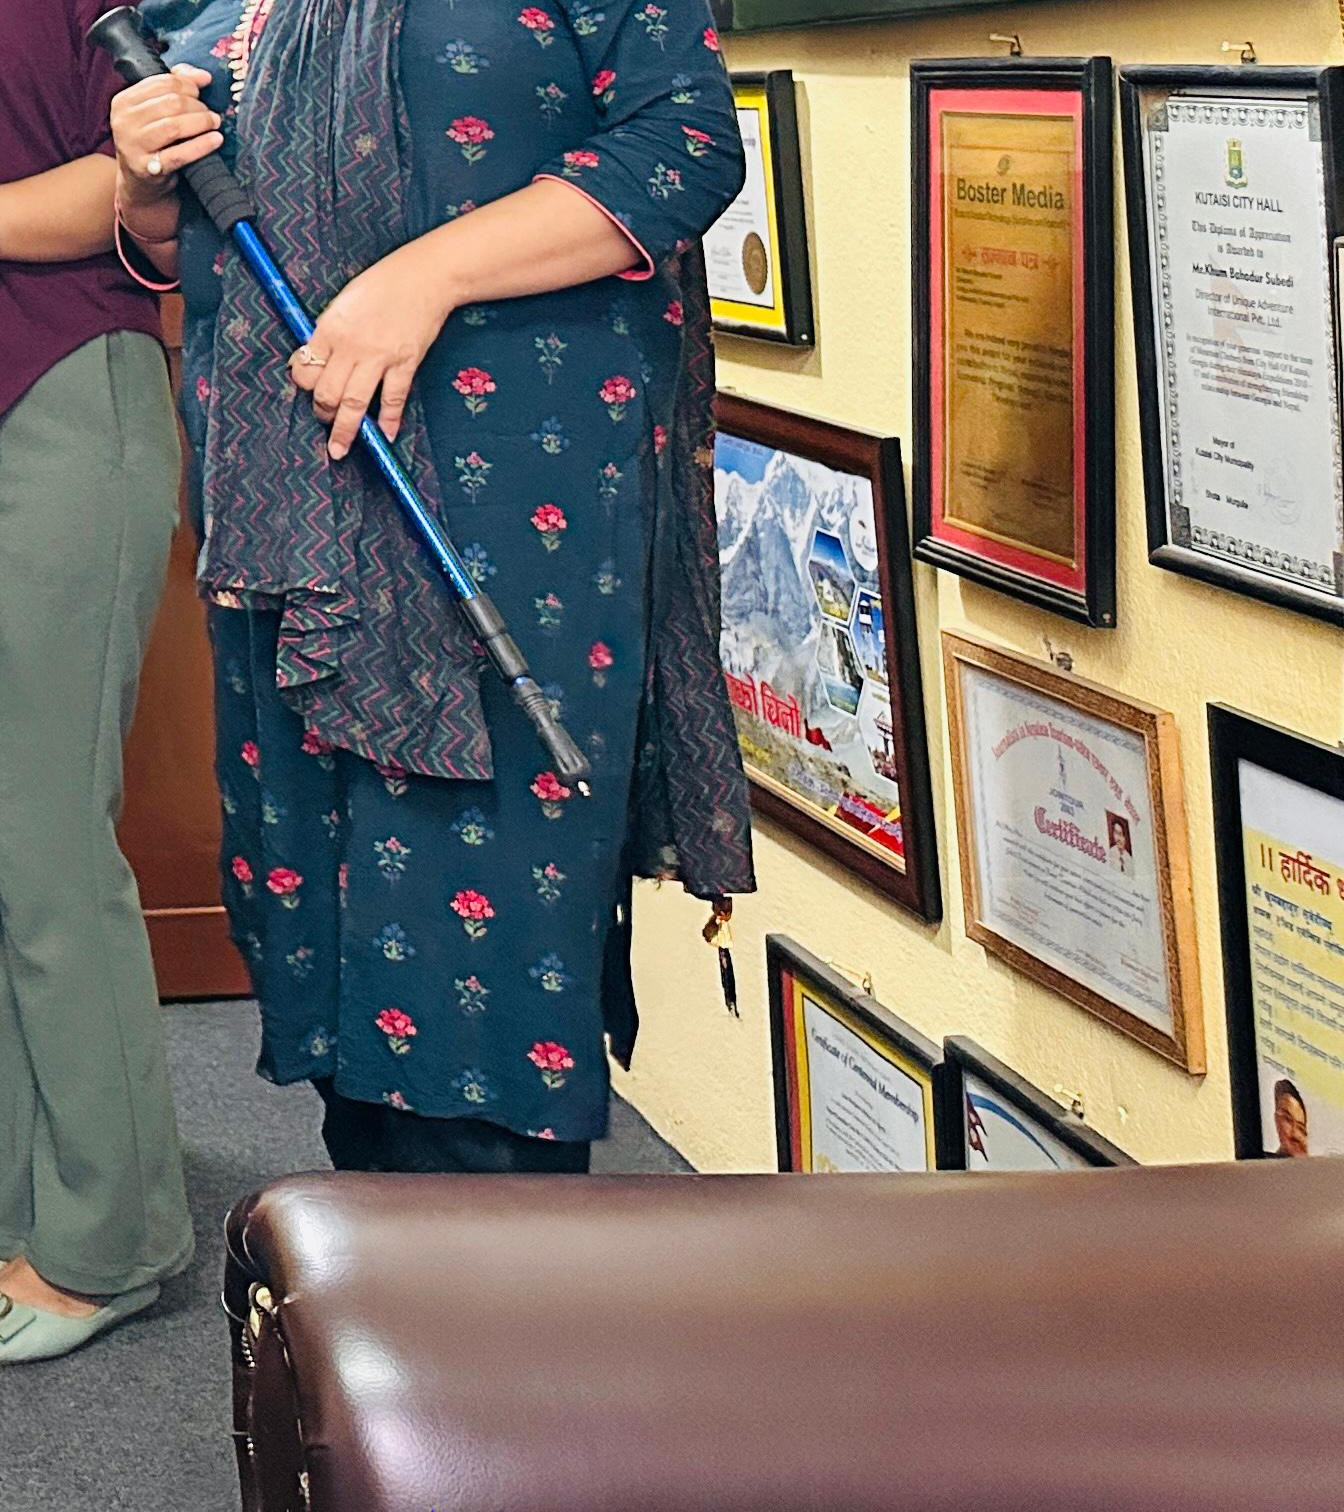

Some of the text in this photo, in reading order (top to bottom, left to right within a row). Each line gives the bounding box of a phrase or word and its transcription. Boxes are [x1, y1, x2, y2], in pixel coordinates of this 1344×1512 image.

[957, 177, 1065, 211] Boster Media
[1195, 191, 1284, 213] KUTAISI CITY HALL
[1191, 219, 1207, 233] This
[1209, 222, 1238, 237] Diploma
[1239, 226, 1247, 238] of
[1229, 266, 1264, 285] Bahadur
[1265, 271, 1295, 289] Subedi
[1195, 287, 1295, 315] Director of Unique Adventure
[1208, 305, 1250, 324] International
[1033, 805, 1108, 864] Certificate
[1278, 849, 1331, 897] हार्दिक
